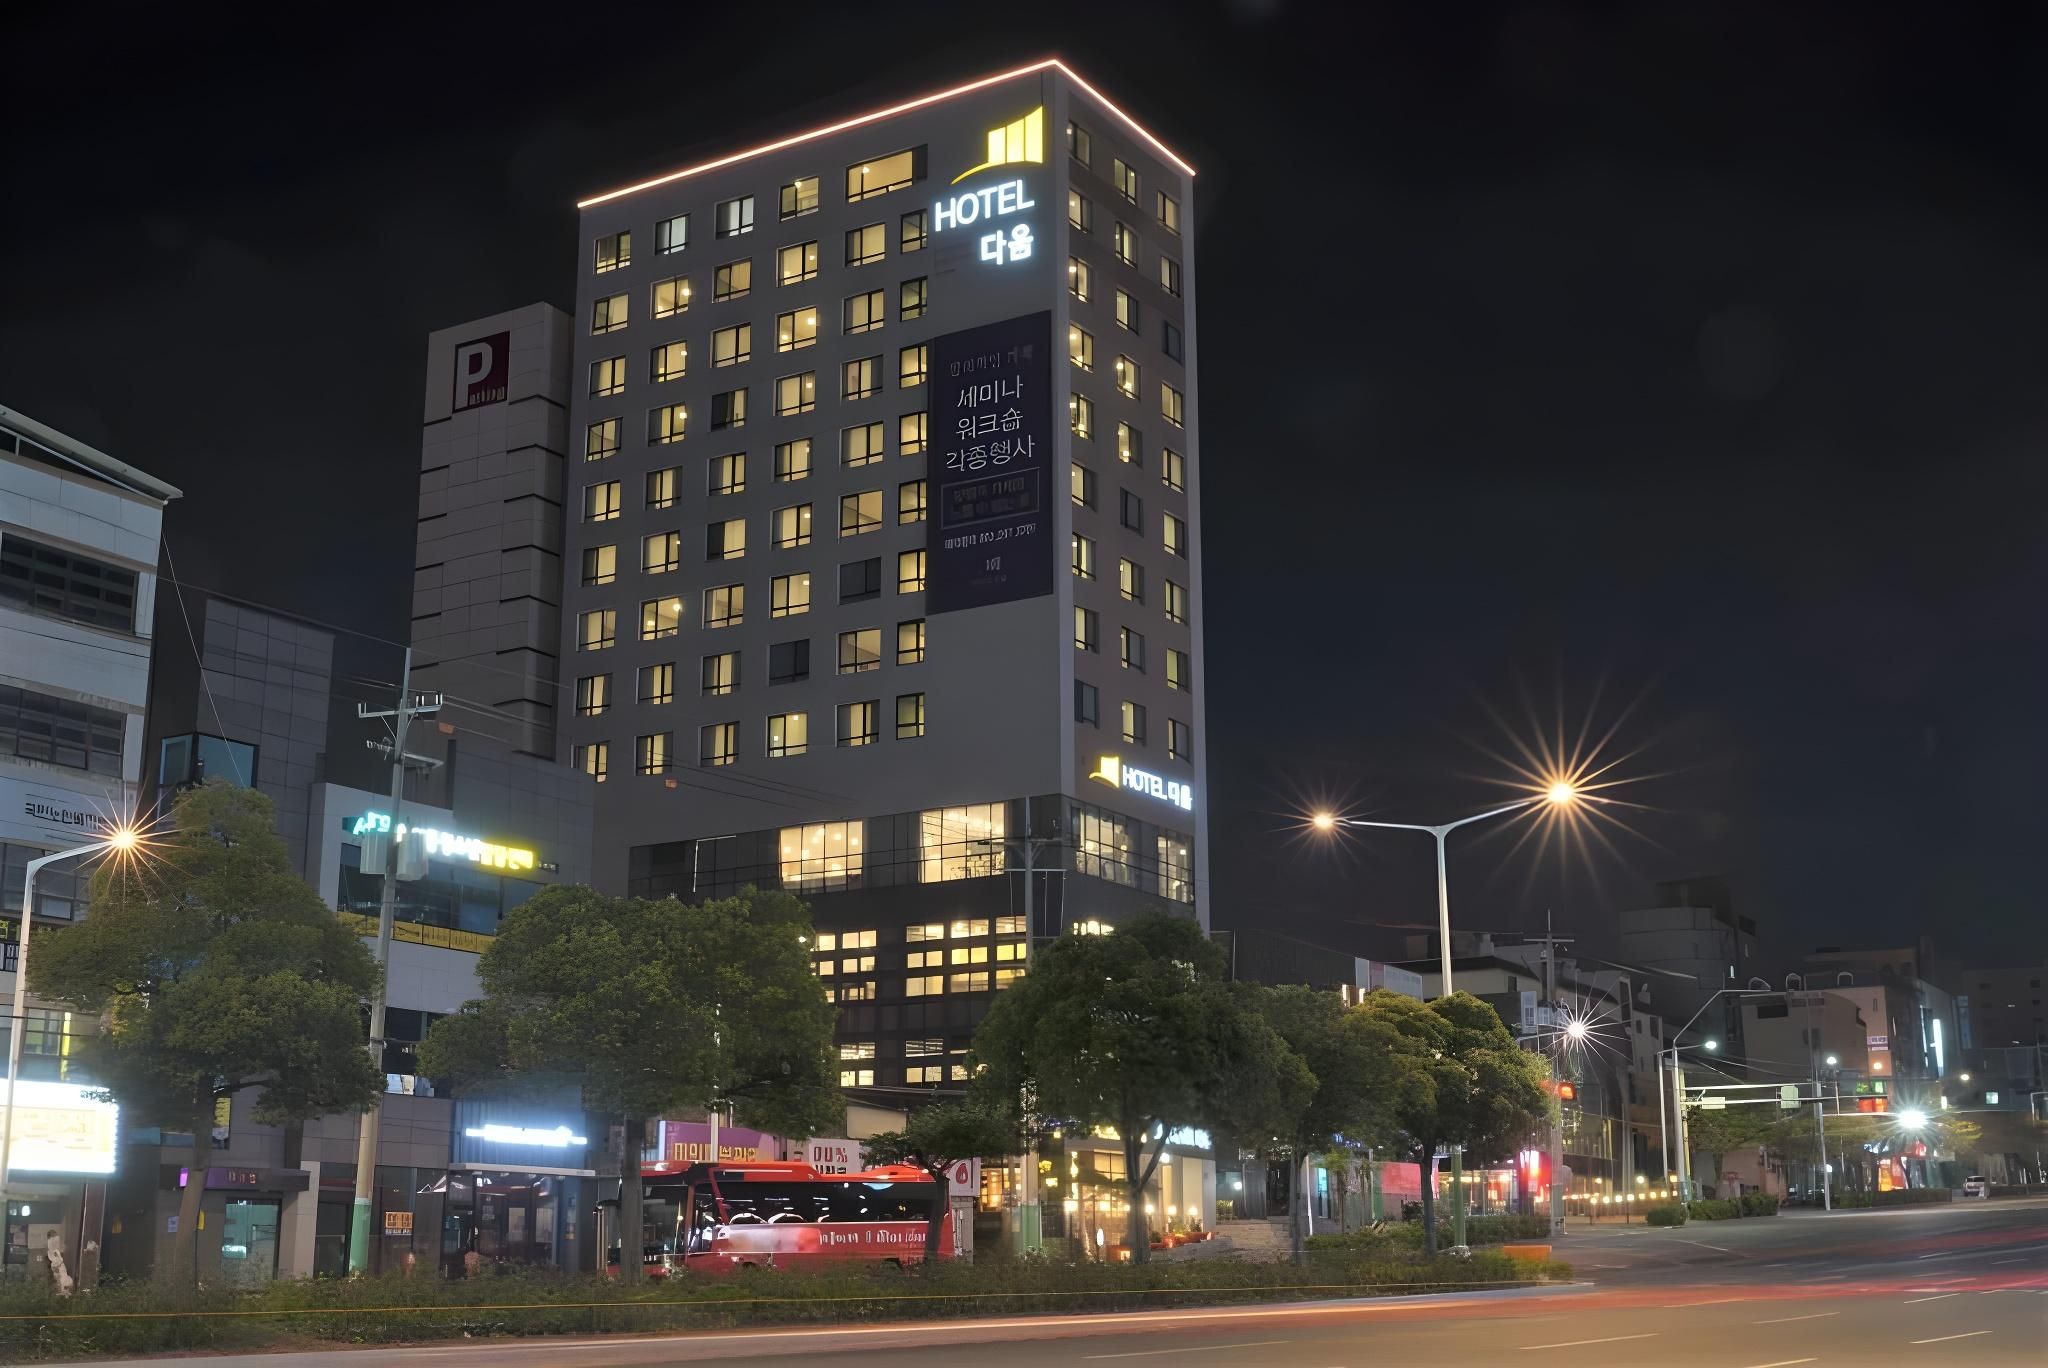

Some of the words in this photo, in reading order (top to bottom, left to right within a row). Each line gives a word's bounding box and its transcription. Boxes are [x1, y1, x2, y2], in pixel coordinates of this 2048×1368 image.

[934, 179, 1035, 232] HOTEL
[957, 374, 1024, 408] 세미나
[946, 434, 1036, 472] 각종행사
[1122, 764, 1167, 801] HOTEL
